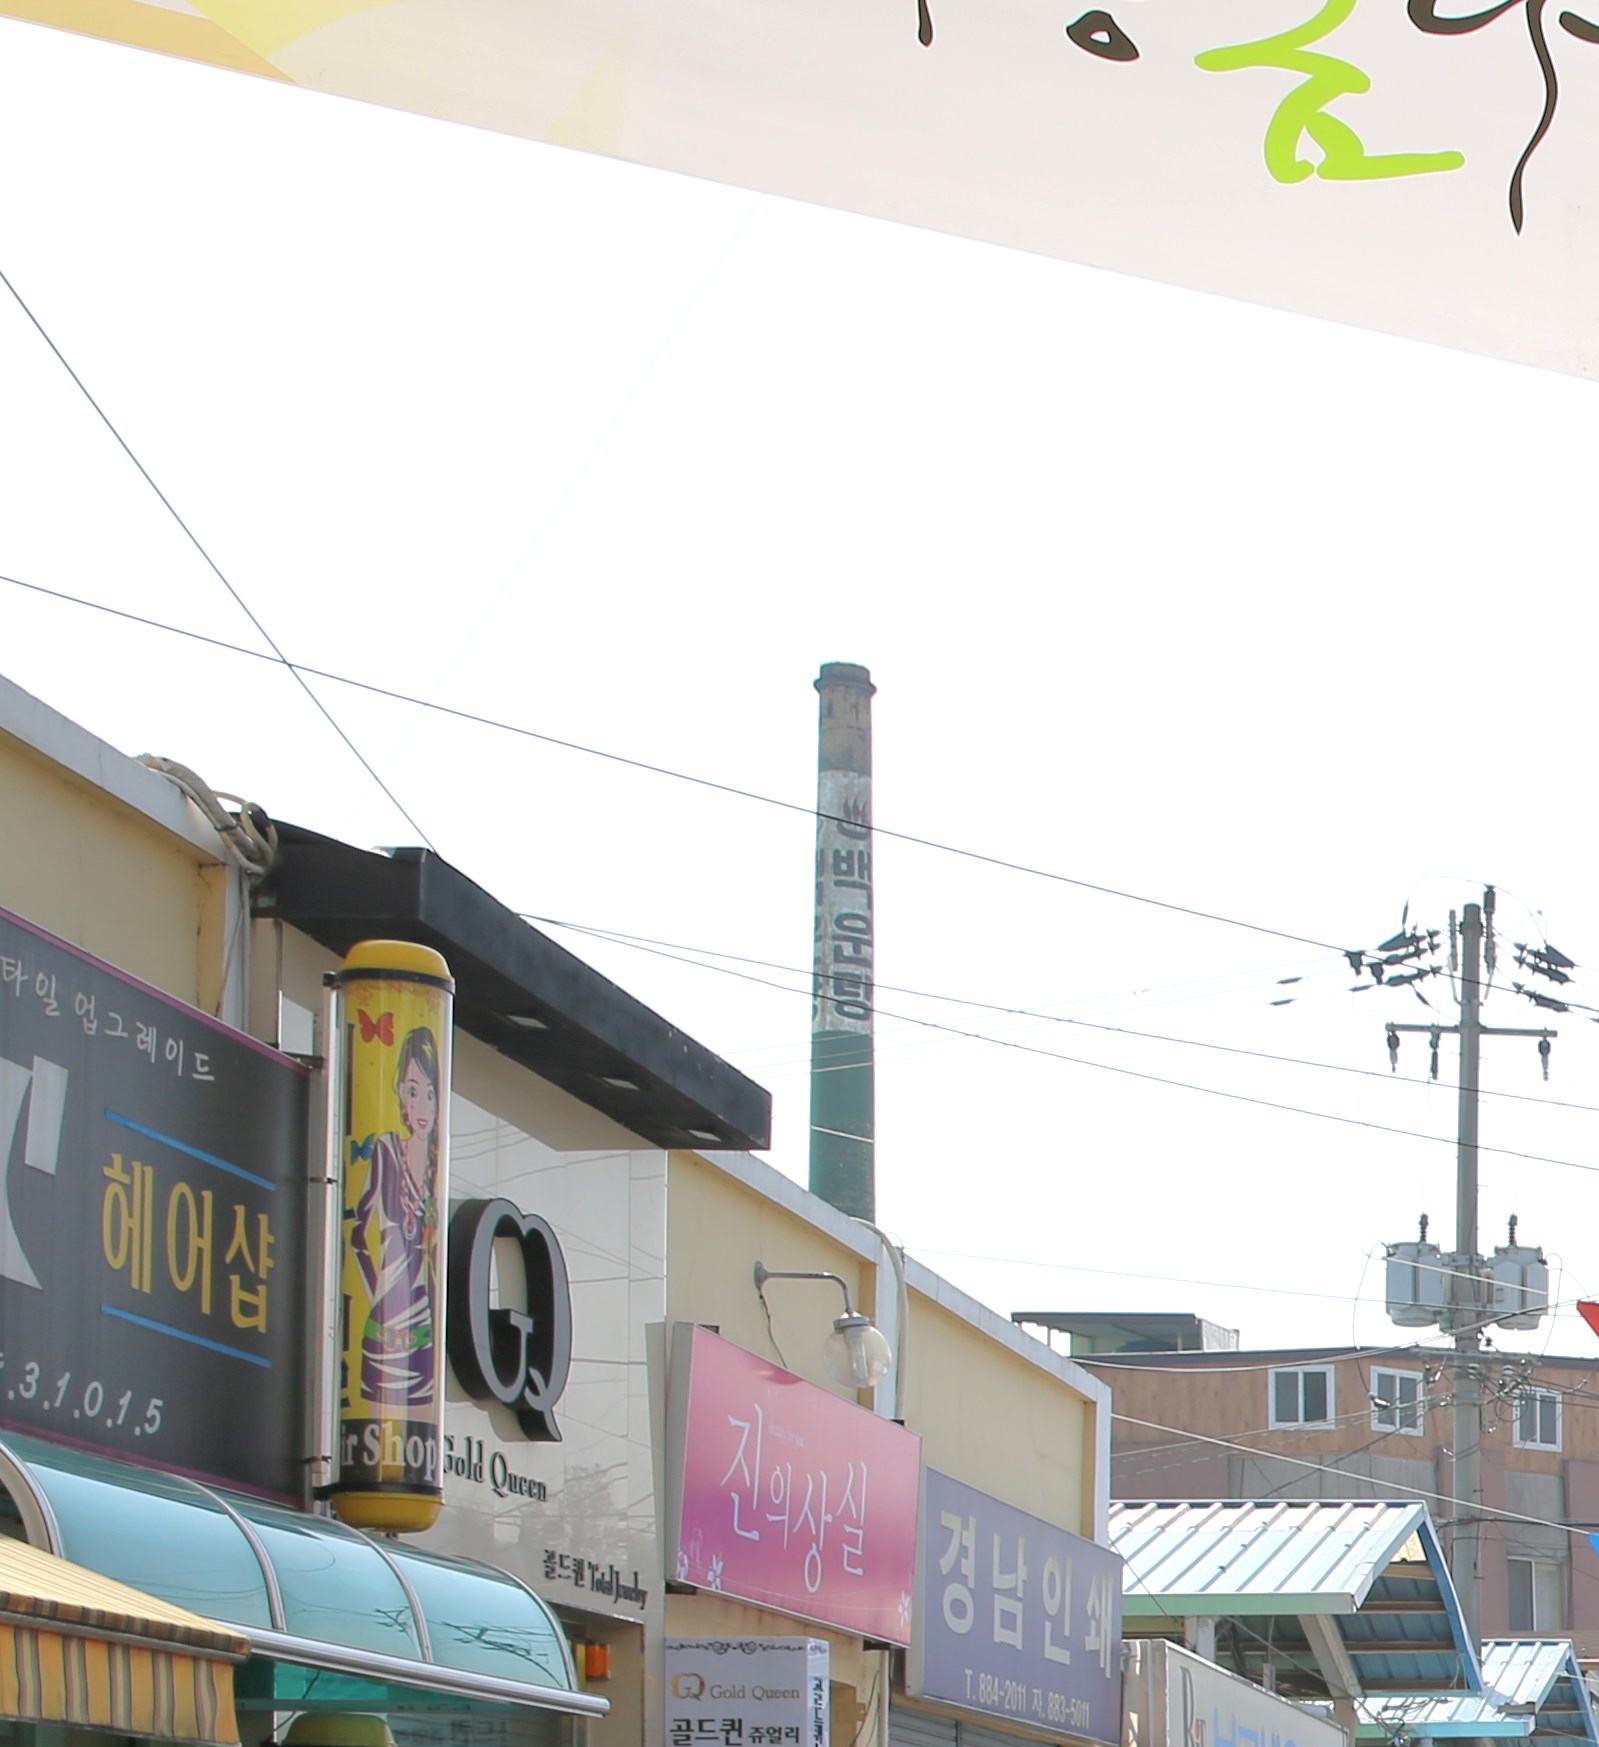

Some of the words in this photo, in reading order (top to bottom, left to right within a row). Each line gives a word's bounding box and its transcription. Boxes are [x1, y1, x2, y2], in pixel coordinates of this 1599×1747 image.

[75, 991, 215, 1081] 업그레이드
[102, 1152, 275, 1334] 헤어샵
[362, 1420, 436, 1482] Shop
[443, 1434, 484, 1484] Gold
[489, 1451, 549, 1502] Queen
[720, 1402, 868, 1594] 진의상실
[938, 1509, 1115, 1679] 경남인쇄
[710, 1684, 746, 1700] Gold
[751, 1685, 801, 1701] Queen
[978, 1671, 1027, 1713] 884-2011
[669, 1717, 744, 1747] 골드퀸
[748, 1726, 800, 1745] 쥬얼리
